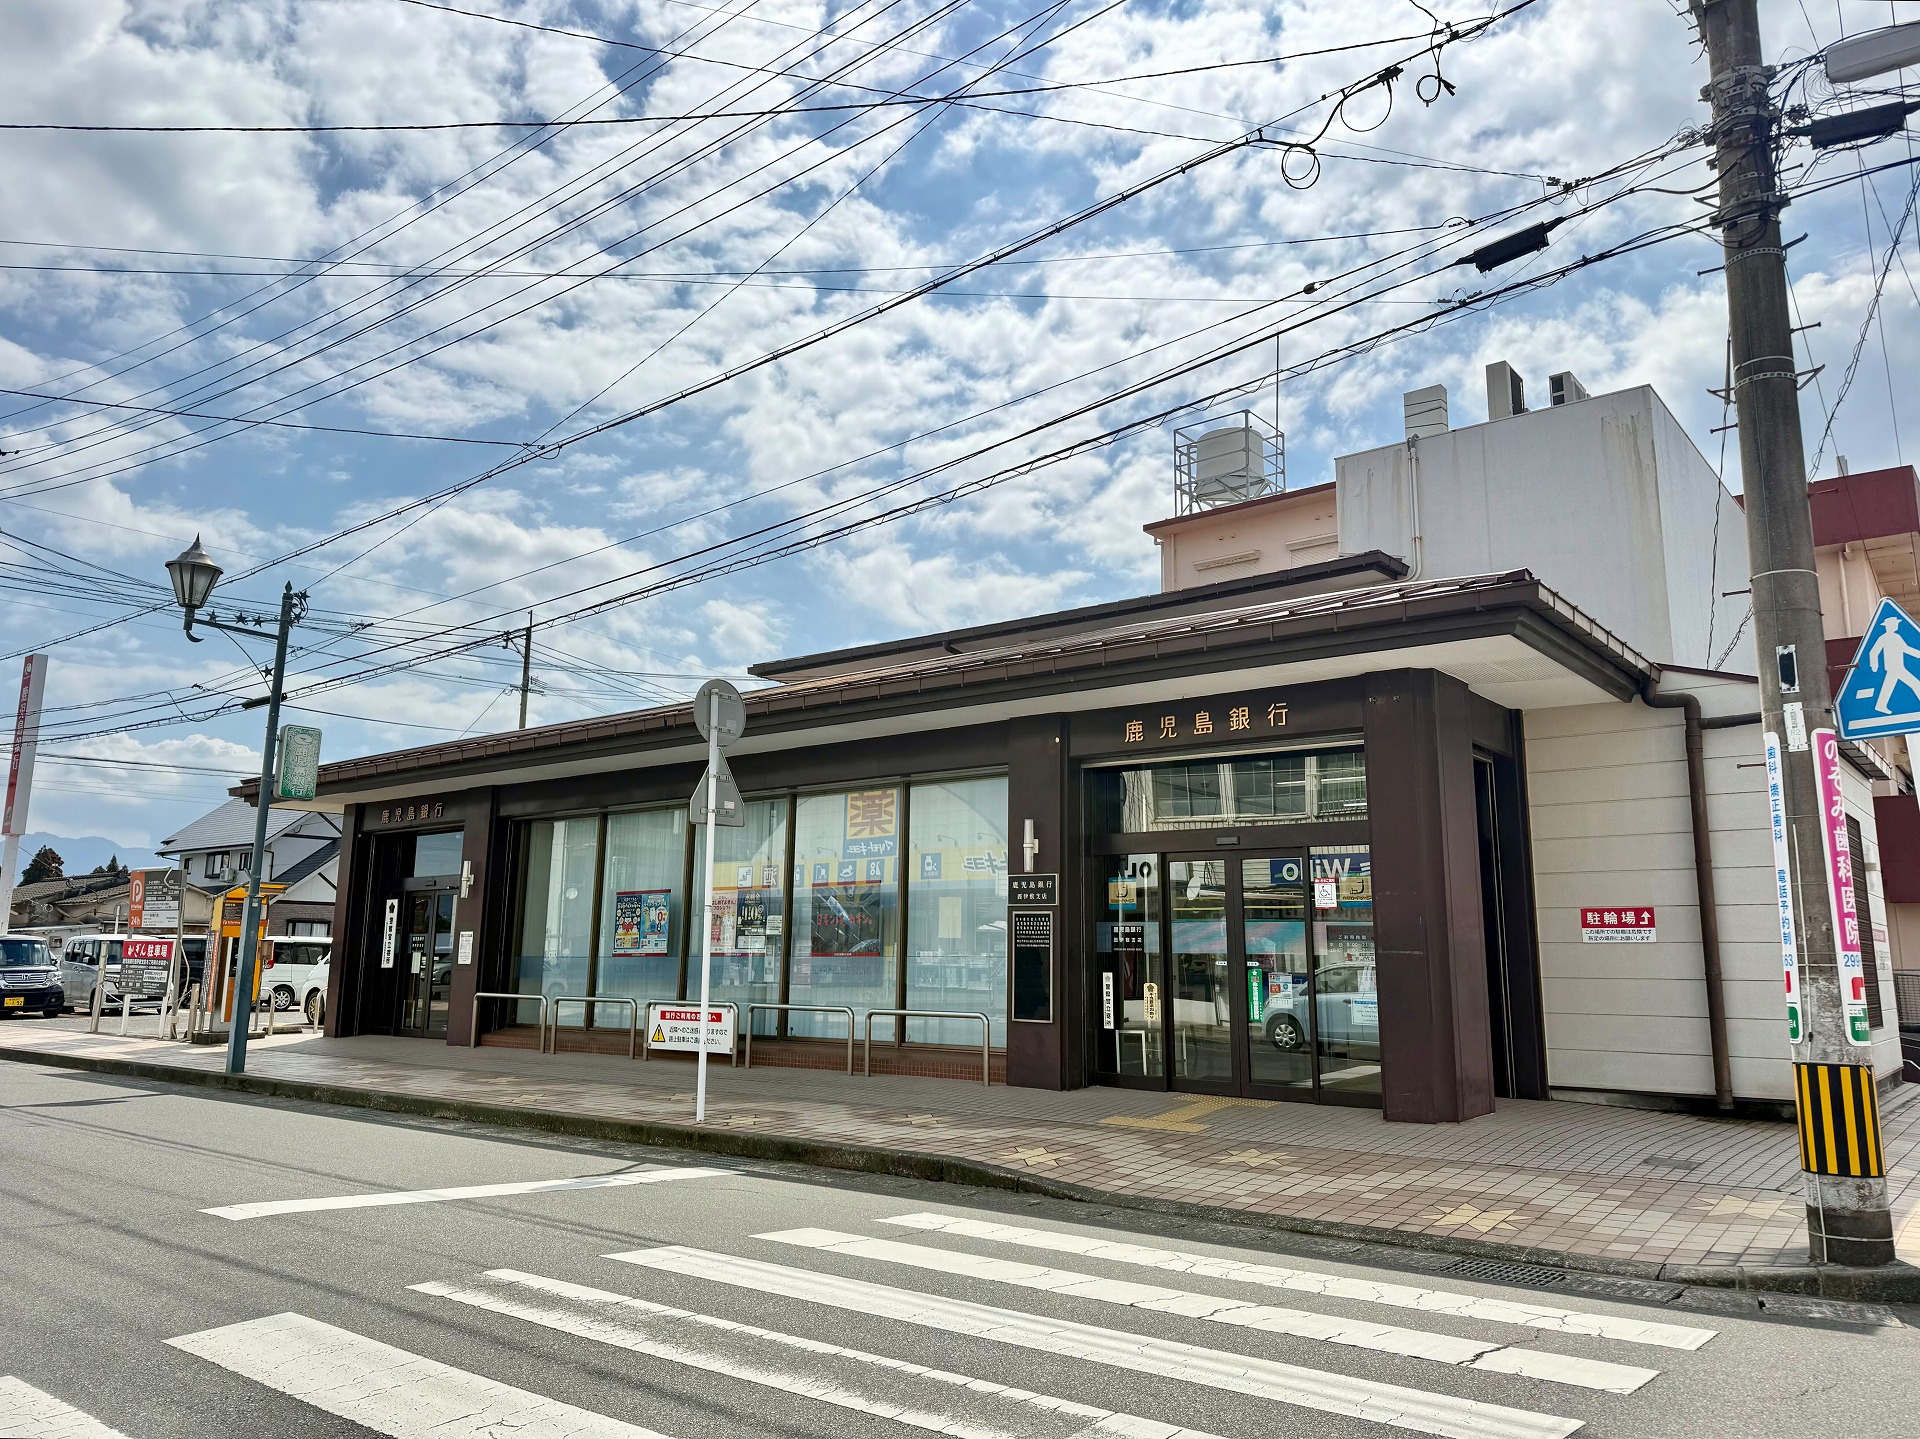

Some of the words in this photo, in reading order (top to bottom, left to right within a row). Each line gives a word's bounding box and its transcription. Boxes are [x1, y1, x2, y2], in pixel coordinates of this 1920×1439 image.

[1124, 703, 1289, 743] 鹿児島銀行
[382, 802, 443, 824] 鹿児島銀行
[1012, 880, 1052, 889] 鹿児島銀行
[1586, 911, 1636, 925] 駐輪場
[127, 943, 168, 958] かぎん駐車場
